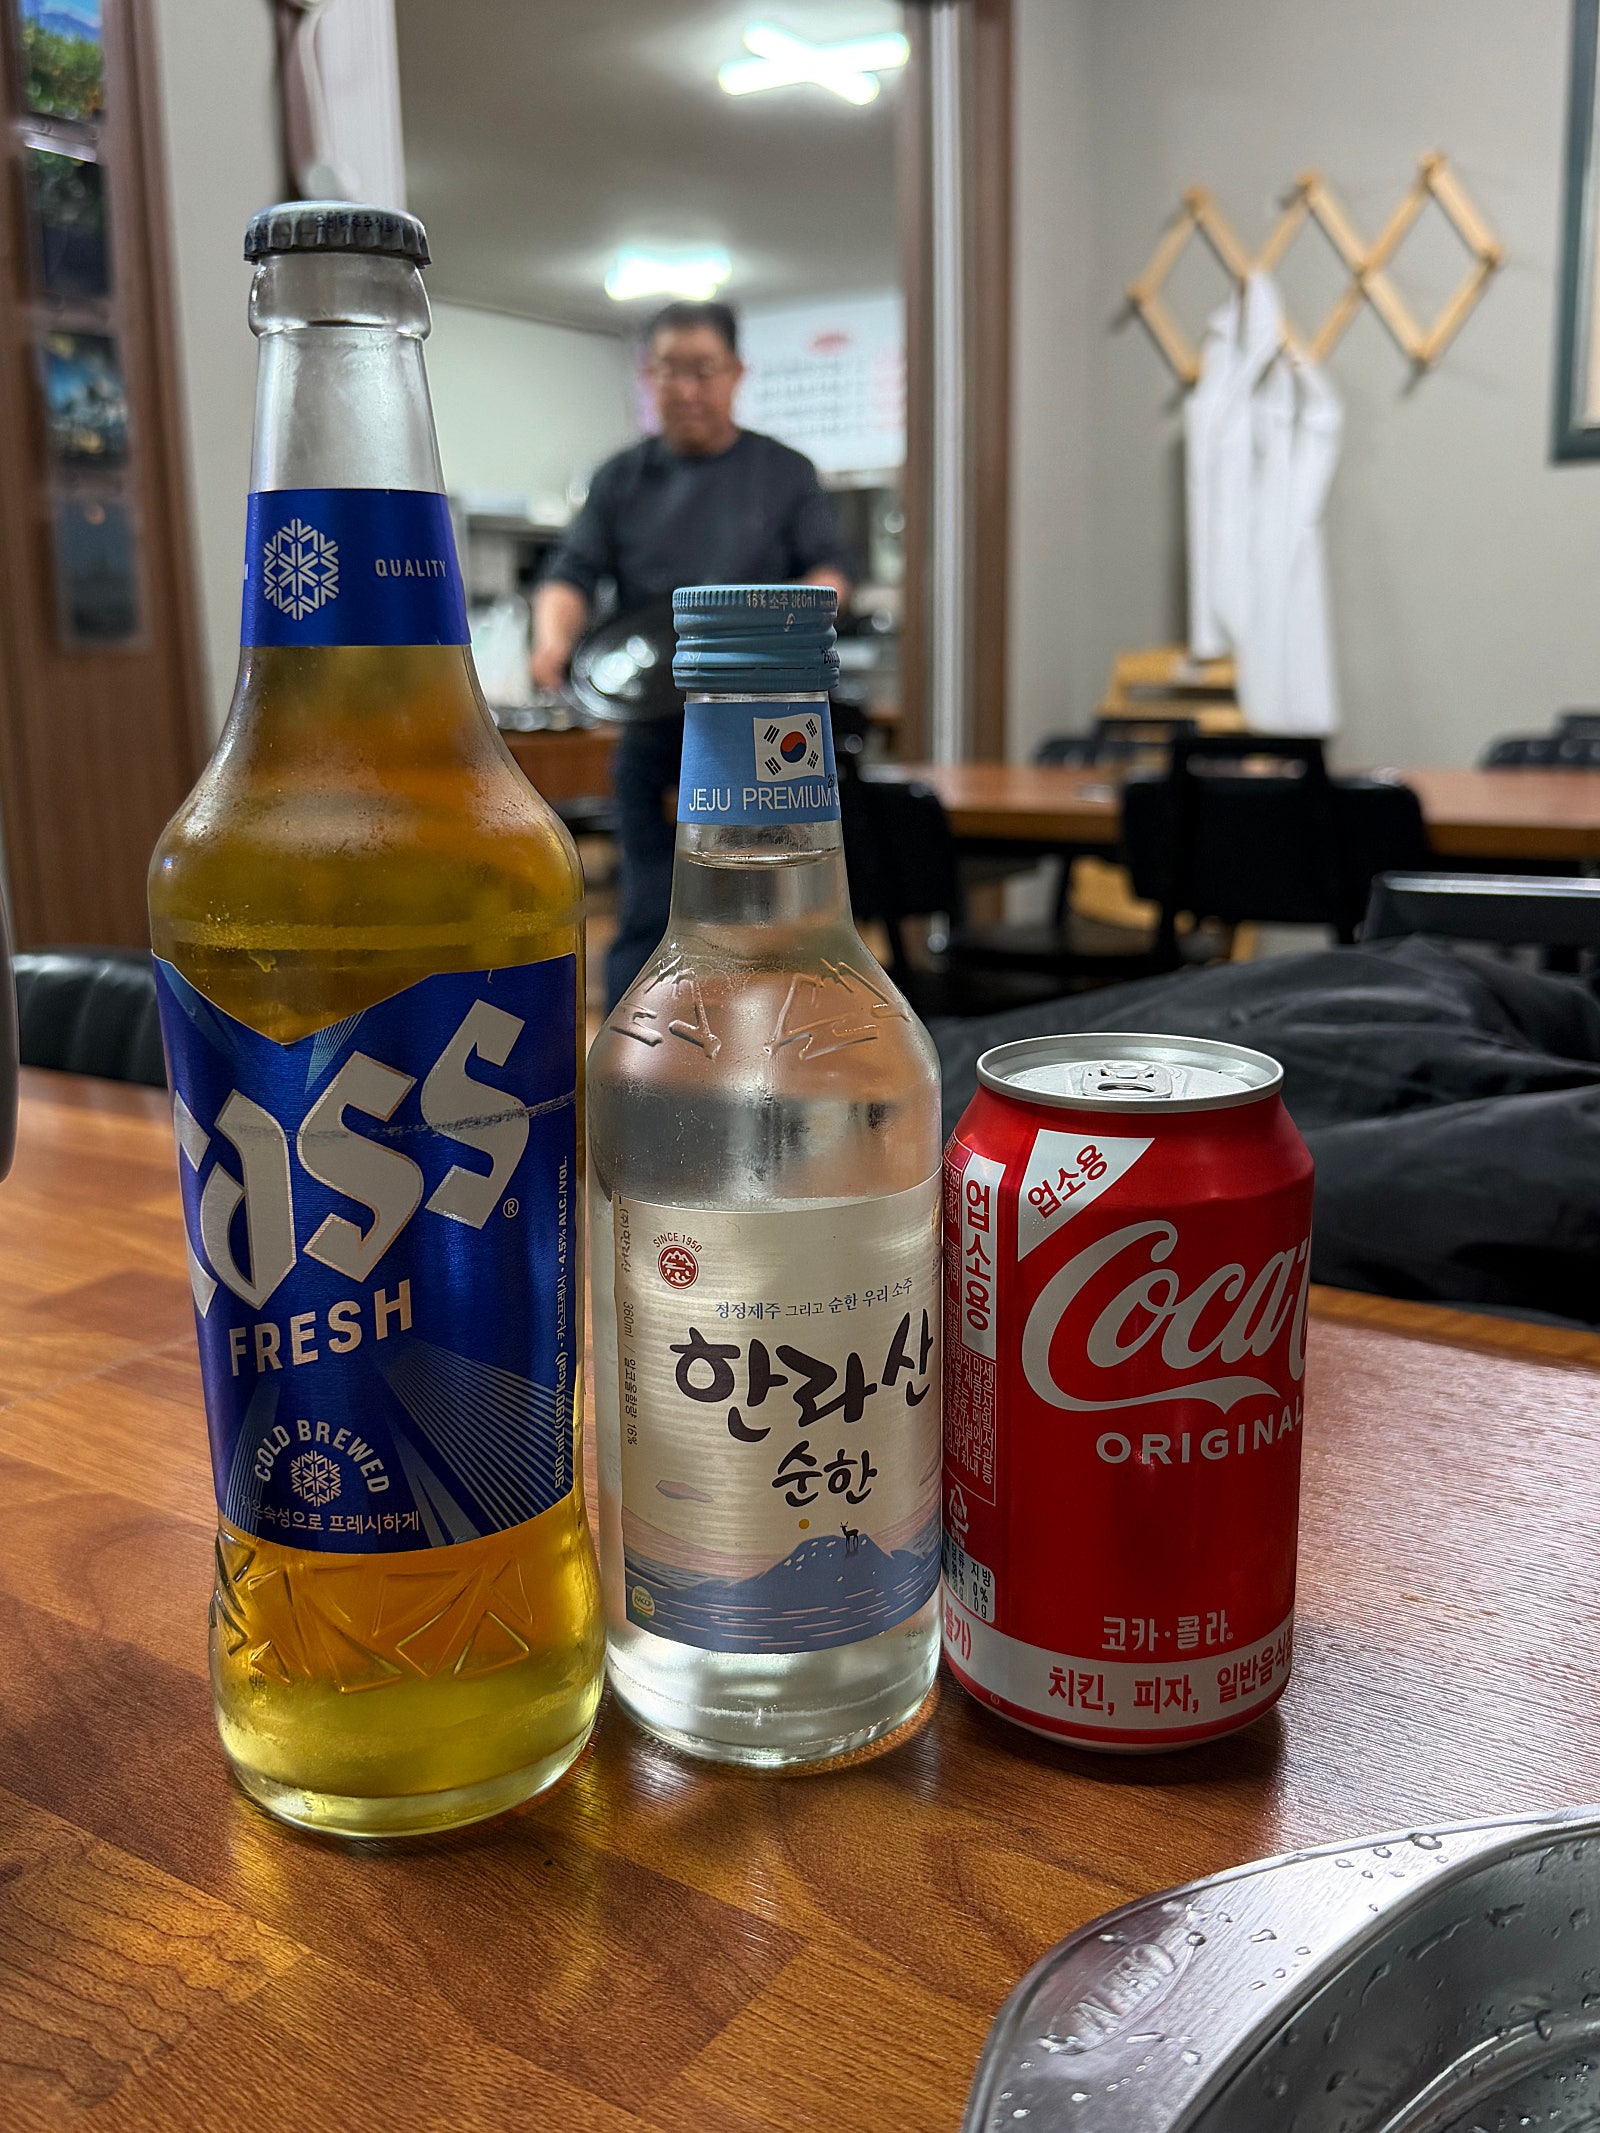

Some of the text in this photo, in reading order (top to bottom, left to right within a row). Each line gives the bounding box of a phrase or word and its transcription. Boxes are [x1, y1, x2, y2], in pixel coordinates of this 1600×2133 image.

[375, 558, 447, 578] QUALITY
[769, 593, 789, 611] 소주
[688, 788, 731, 812] JEJU
[742, 786, 832, 811] PREMIUM
[558, 1155, 568, 1226] ALC./VOL.
[1027, 1144, 1108, 1219] 업소용
[558, 1228, 568, 1264] 4.5%
[653, 1232, 703, 1253] SINCE 1950
[965, 1179, 992, 1331] 업소용
[623, 1301, 634, 1337] 360ml
[715, 1277, 913, 1320] 청정제주 그리고 순한 우리 소주
[229, 1279, 413, 1377] FRESH
[624, 1357, 638, 1418] 알코올함량
[670, 1308, 934, 1442] 한라산
[627, 1423, 638, 1445] 16%
[1096, 1396, 1303, 1466] ORIGINAL
[254, 1419, 390, 1493] COLD BREWED
[554, 1454, 565, 1489] 500
[771, 1440, 878, 1508] 순한
[329, 1510, 420, 1535] 프레시하게
[970, 1560, 992, 1588] 지방
[1048, 1665, 1115, 1717] 치킨,
[1133, 1674, 1200, 1714] 피자,
